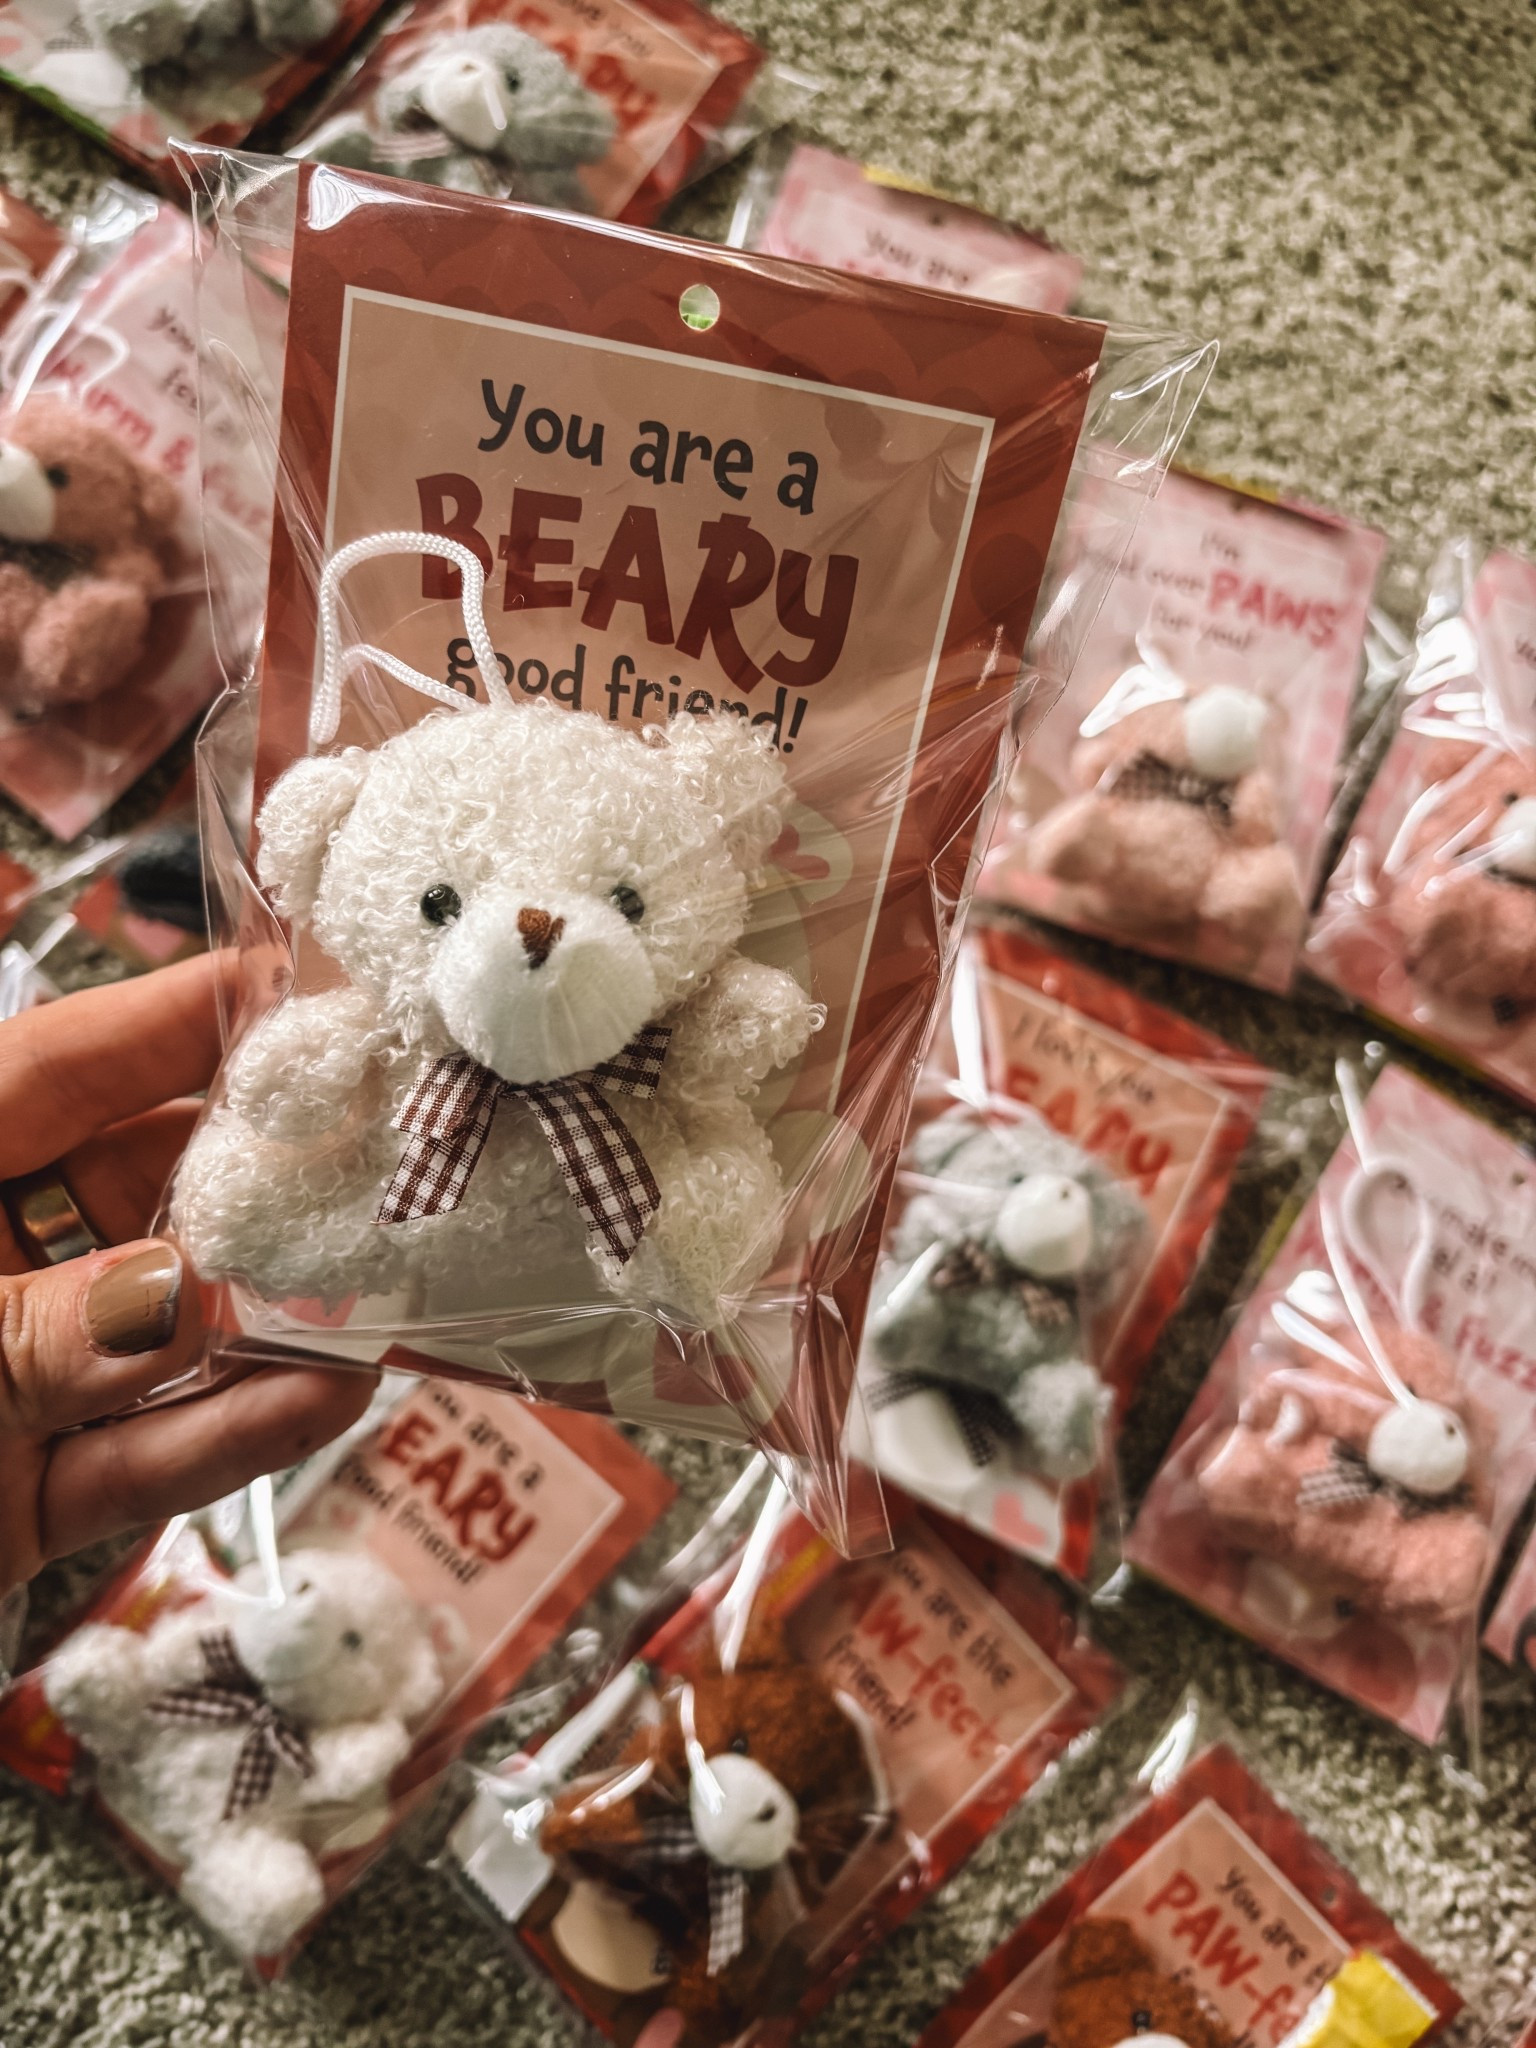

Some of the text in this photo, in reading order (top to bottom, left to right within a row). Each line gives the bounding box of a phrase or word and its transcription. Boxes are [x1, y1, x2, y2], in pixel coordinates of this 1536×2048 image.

[630, 420, 754, 501] are
[777, 451, 818, 515] a
[415, 472, 859, 694] BEARY
[1207, 568, 1338, 648] PAWS
[445, 638, 808, 753] good friend!
[1005, 1063, 1174, 1197] EARY
[384, 1410, 538, 1563] EARY
[1144, 1868, 1302, 2044] PAW-fe
[1262, 1918, 1308, 1968] are
